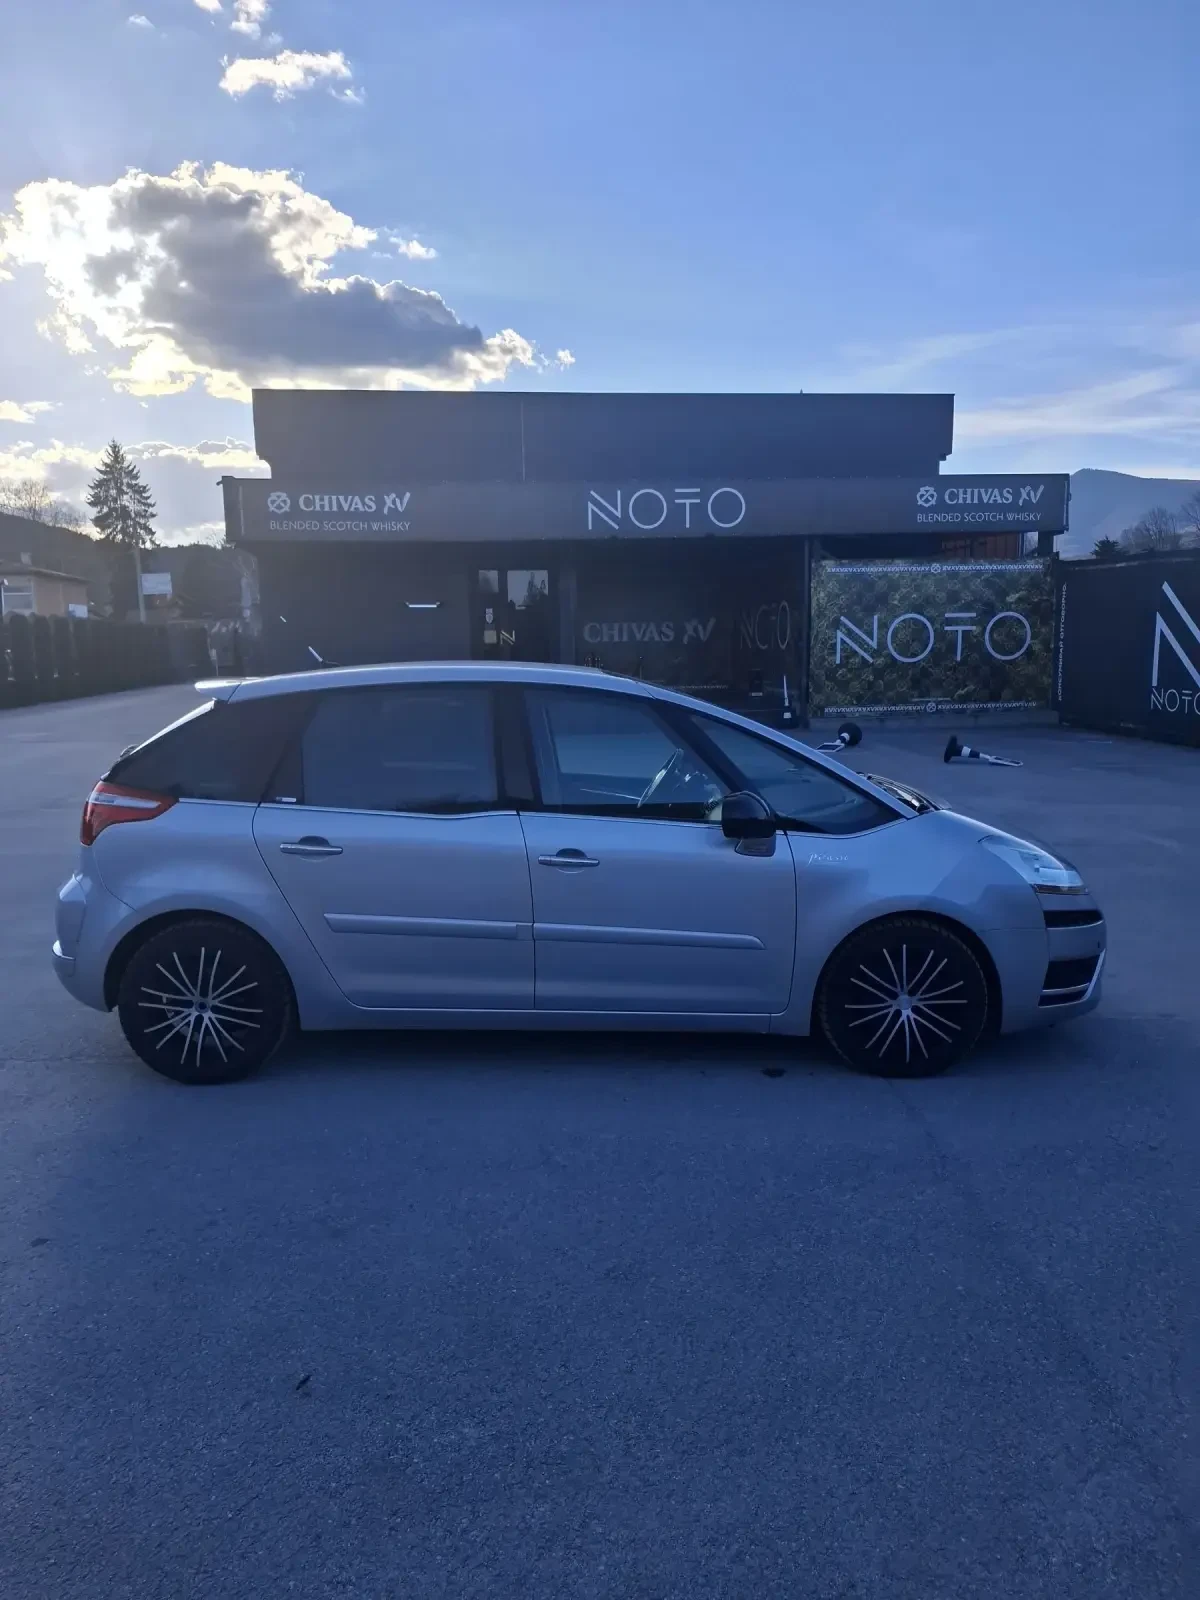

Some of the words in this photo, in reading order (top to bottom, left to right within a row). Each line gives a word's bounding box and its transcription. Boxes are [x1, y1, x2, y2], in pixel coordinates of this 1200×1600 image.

[298, 493, 377, 512] CHIVAS
[383, 491, 411, 515] XV
[944, 487, 1013, 505] CHIVAS
[1018, 484, 1045, 506] XV
[587, 487, 746, 530] NOTO
[917, 513, 961, 523] BLENDED
[964, 512, 1003, 522] SCOTCH
[1006, 512, 1042, 521] WHISKY
[270, 520, 320, 531] BLENDED
[323, 521, 368, 531] SCOTCH
[371, 521, 411, 531] WHISKY
[582, 622, 675, 643] CHIVAS
[836, 611, 1031, 664] NOTO
